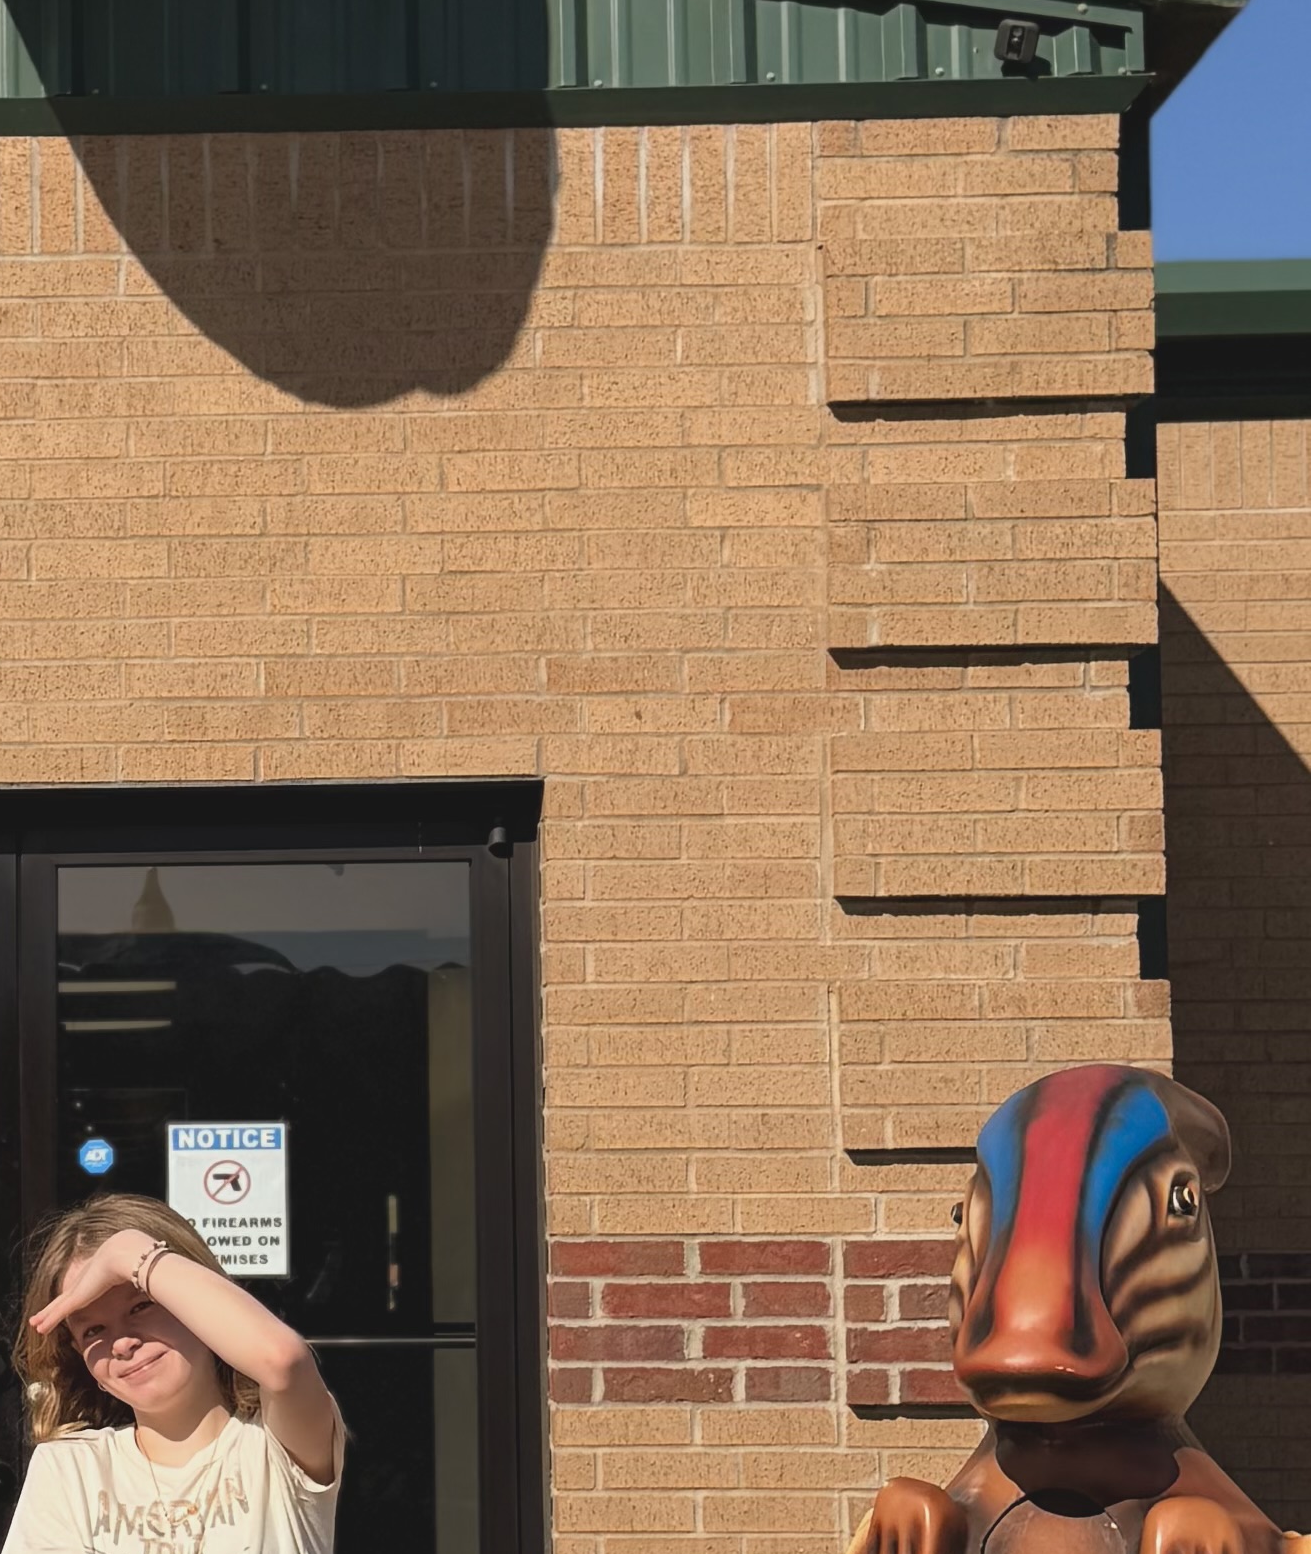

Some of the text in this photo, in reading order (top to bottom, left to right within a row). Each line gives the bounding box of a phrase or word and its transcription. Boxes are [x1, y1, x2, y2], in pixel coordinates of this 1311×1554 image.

[178, 1129, 276, 1148] NOTICE
[202, 1217, 283, 1228] FIREARMS
[206, 1236, 280, 1246] OWED ON
